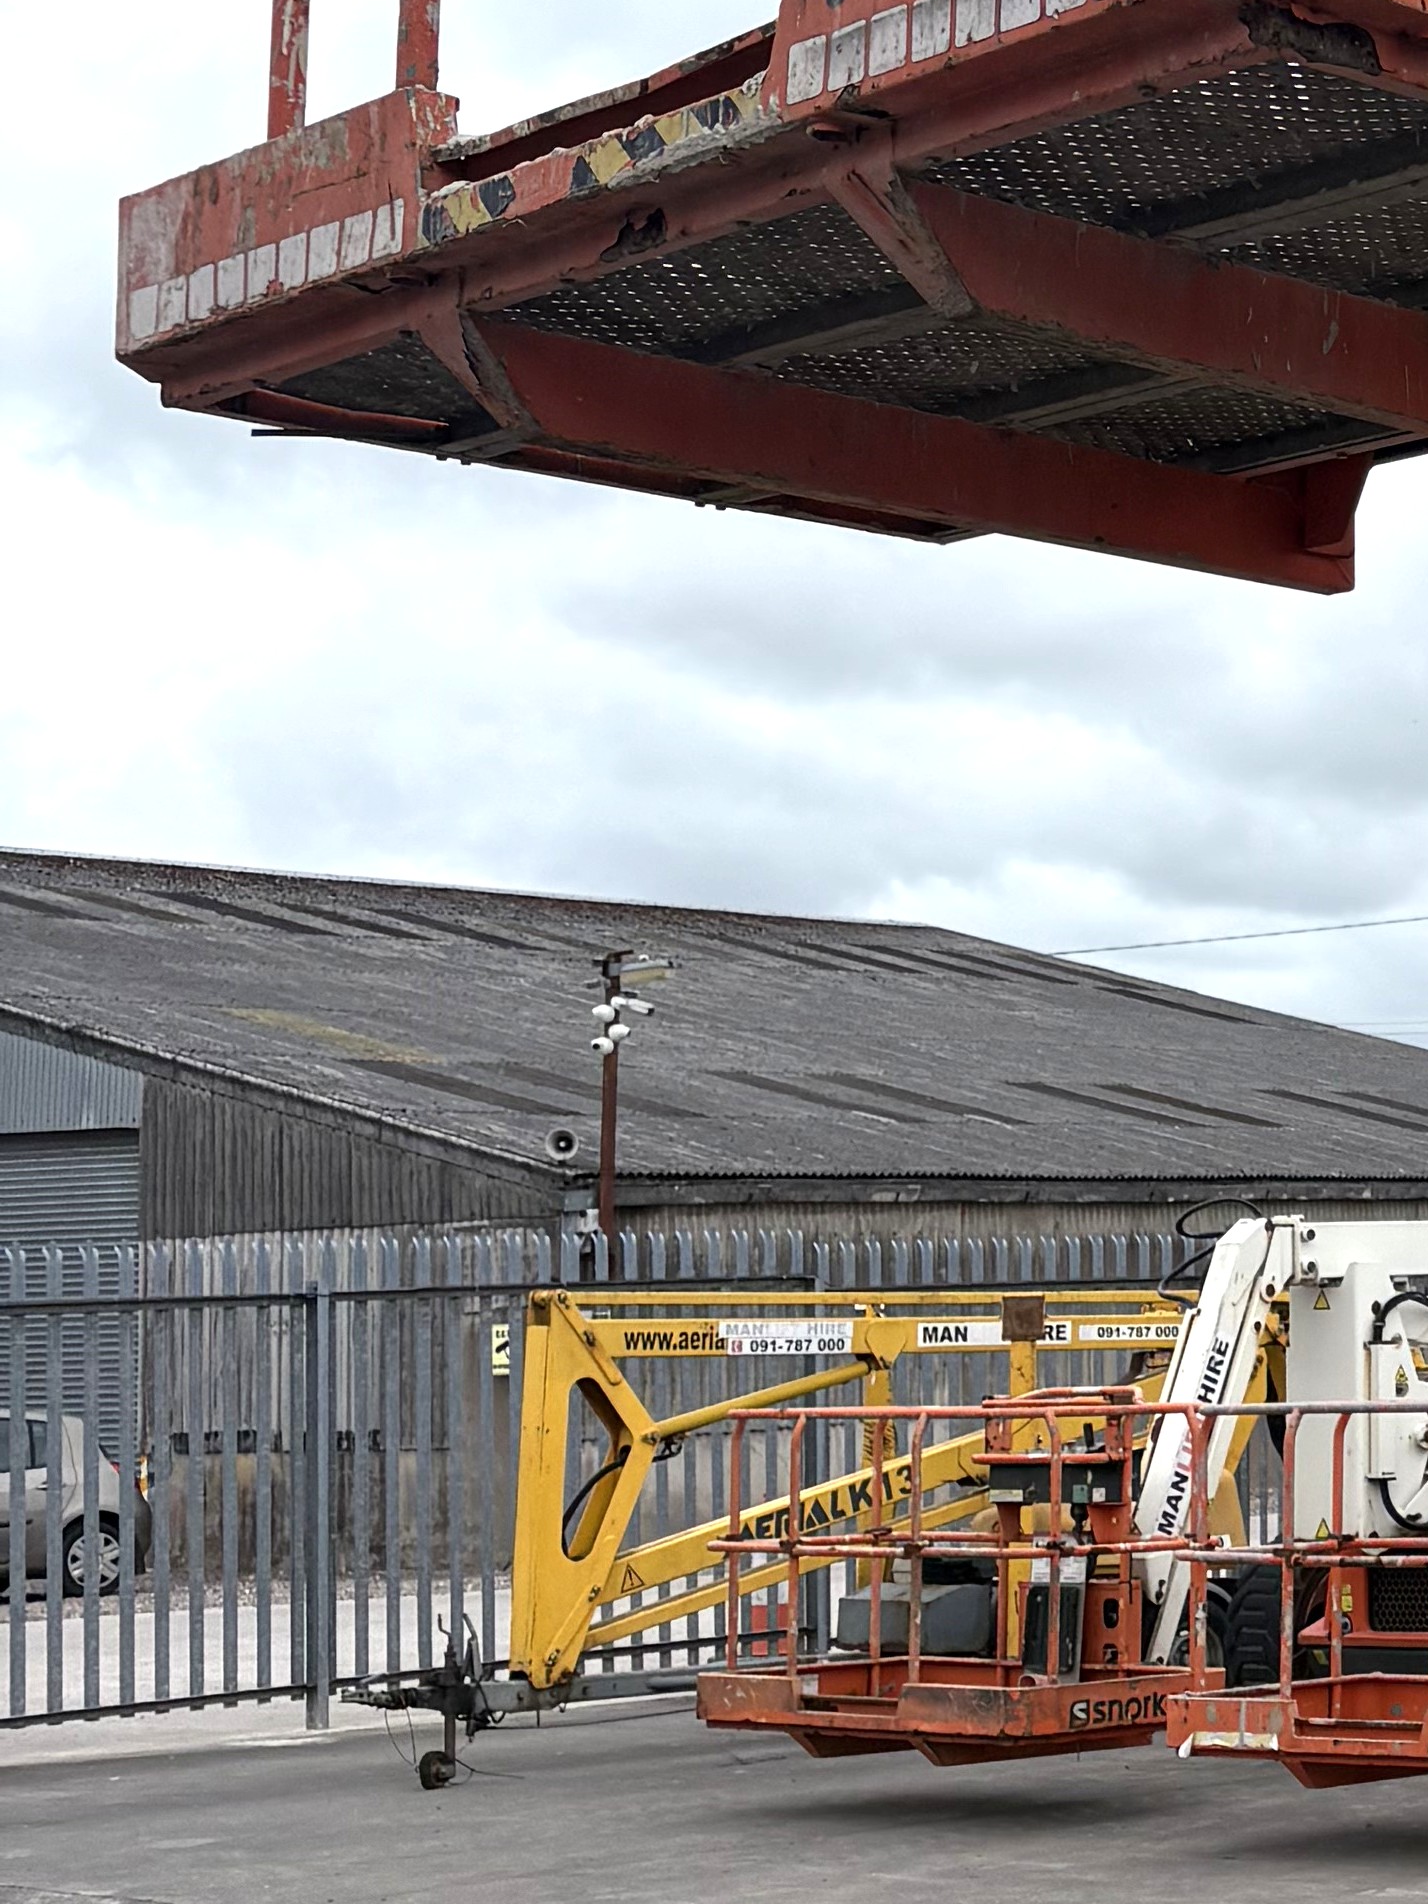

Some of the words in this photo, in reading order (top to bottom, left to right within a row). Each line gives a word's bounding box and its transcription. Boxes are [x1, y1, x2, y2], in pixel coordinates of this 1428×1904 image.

[1042, 1324, 1068, 1342] RE
[1096, 1326, 1151, 1340] 091-787
[1155, 1325, 1179, 1339] 000
[750, 1338, 812, 1353] 091-787
[817, 1337, 845, 1352] 000
[1197, 1337, 1230, 1404] HIRE
[1092, 1691, 1168, 1724] snork
